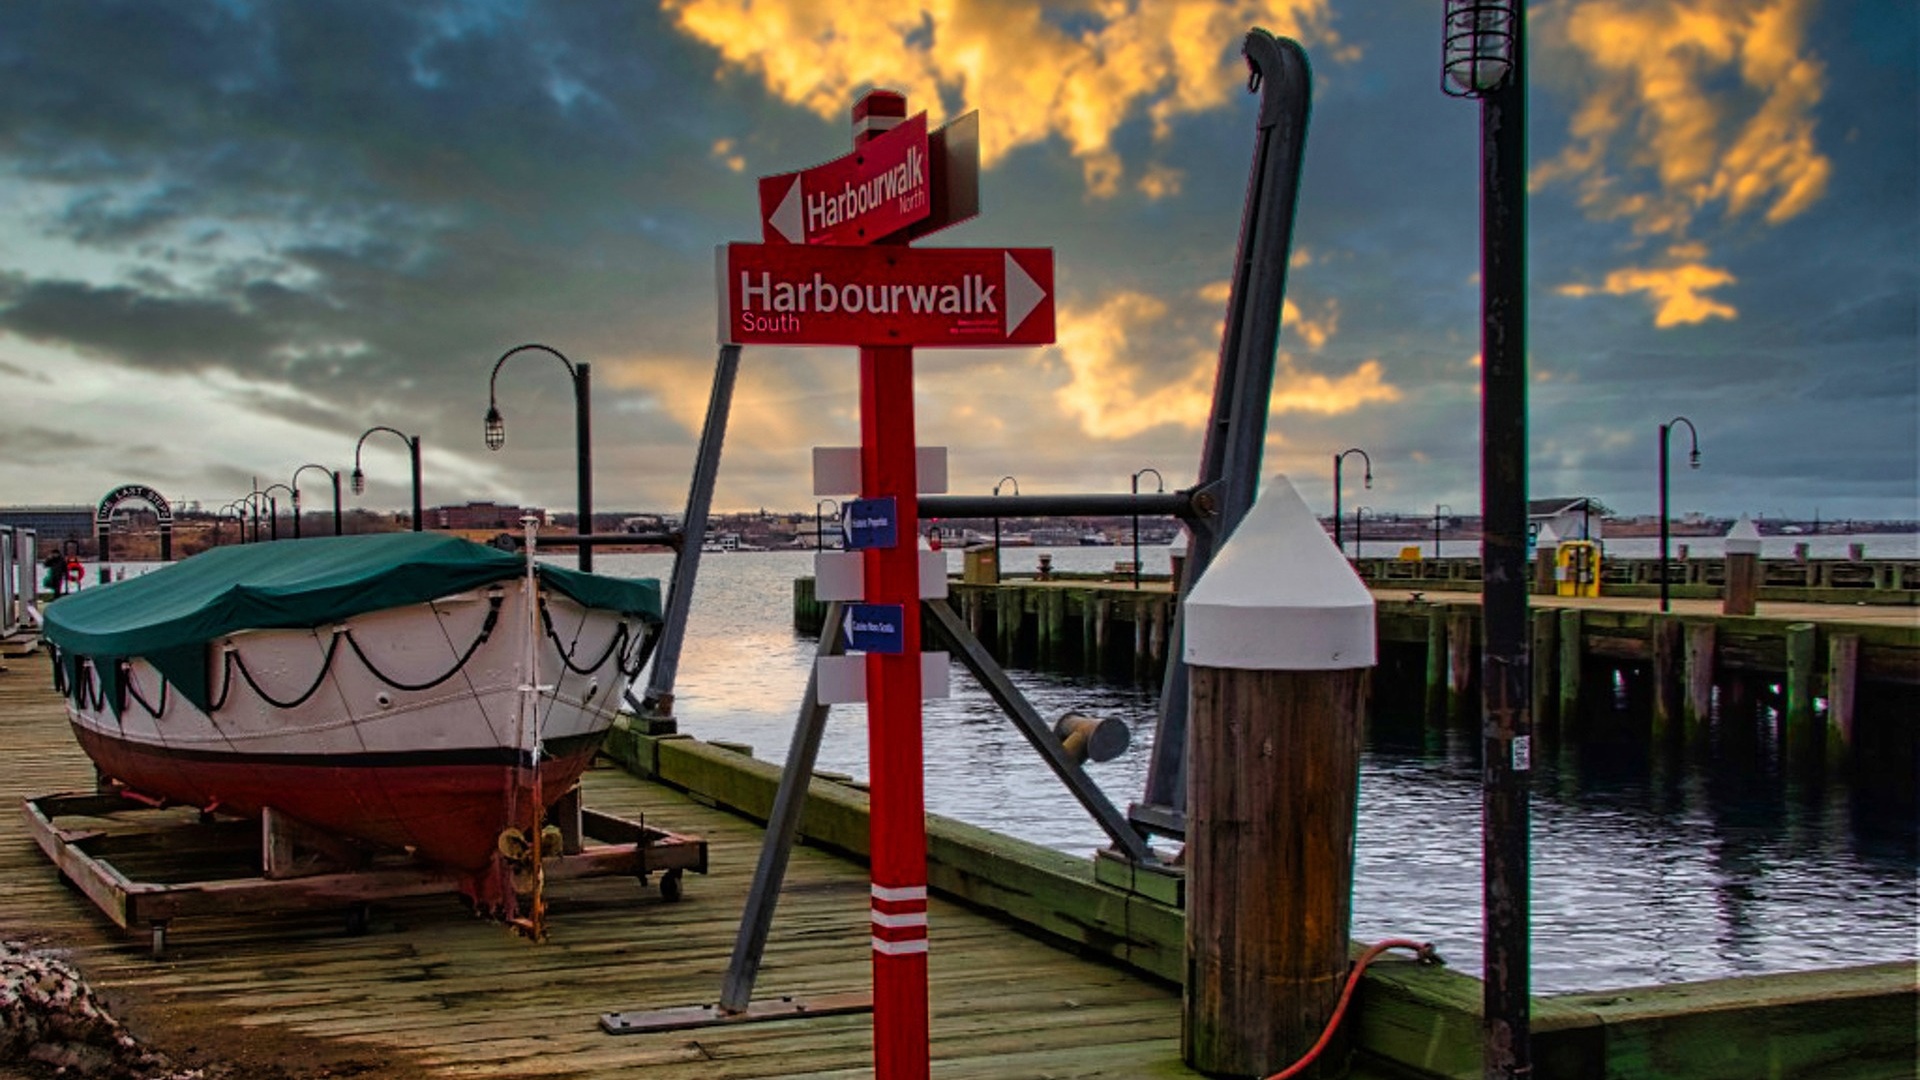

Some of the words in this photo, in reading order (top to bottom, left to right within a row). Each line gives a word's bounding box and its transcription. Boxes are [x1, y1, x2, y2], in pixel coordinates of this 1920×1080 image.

[807, 146, 924, 232] Harbourwalk
[900, 190, 925, 215] North
[741, 271, 998, 314] Harbourwalk
[742, 313, 800, 333] South
